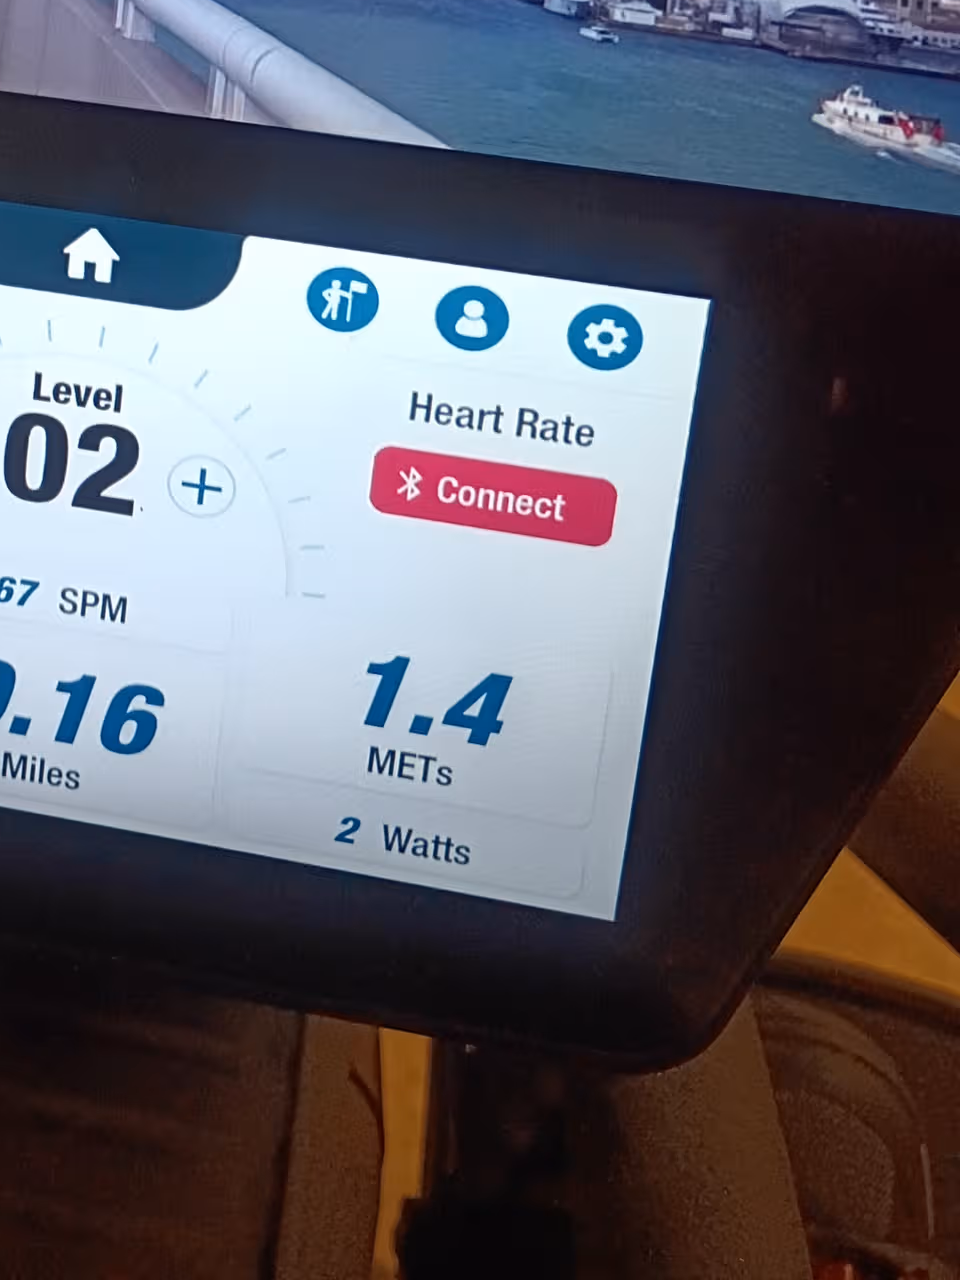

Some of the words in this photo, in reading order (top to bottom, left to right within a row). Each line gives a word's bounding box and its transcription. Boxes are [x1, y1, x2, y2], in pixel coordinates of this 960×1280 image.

[31, 371, 124, 414] Level
[409, 391, 505, 434] Heart
[515, 407, 595, 447] Rate
[2, 412, 140, 517] 02
[436, 475, 566, 523] Connect
[59, 587, 128, 624] SPM
[363, 655, 514, 747] 1.4
[1, 751, 80, 790] Miles
[367, 745, 453, 787] METs
[333, 816, 362, 845] 2
[383, 824, 471, 865] Watts
